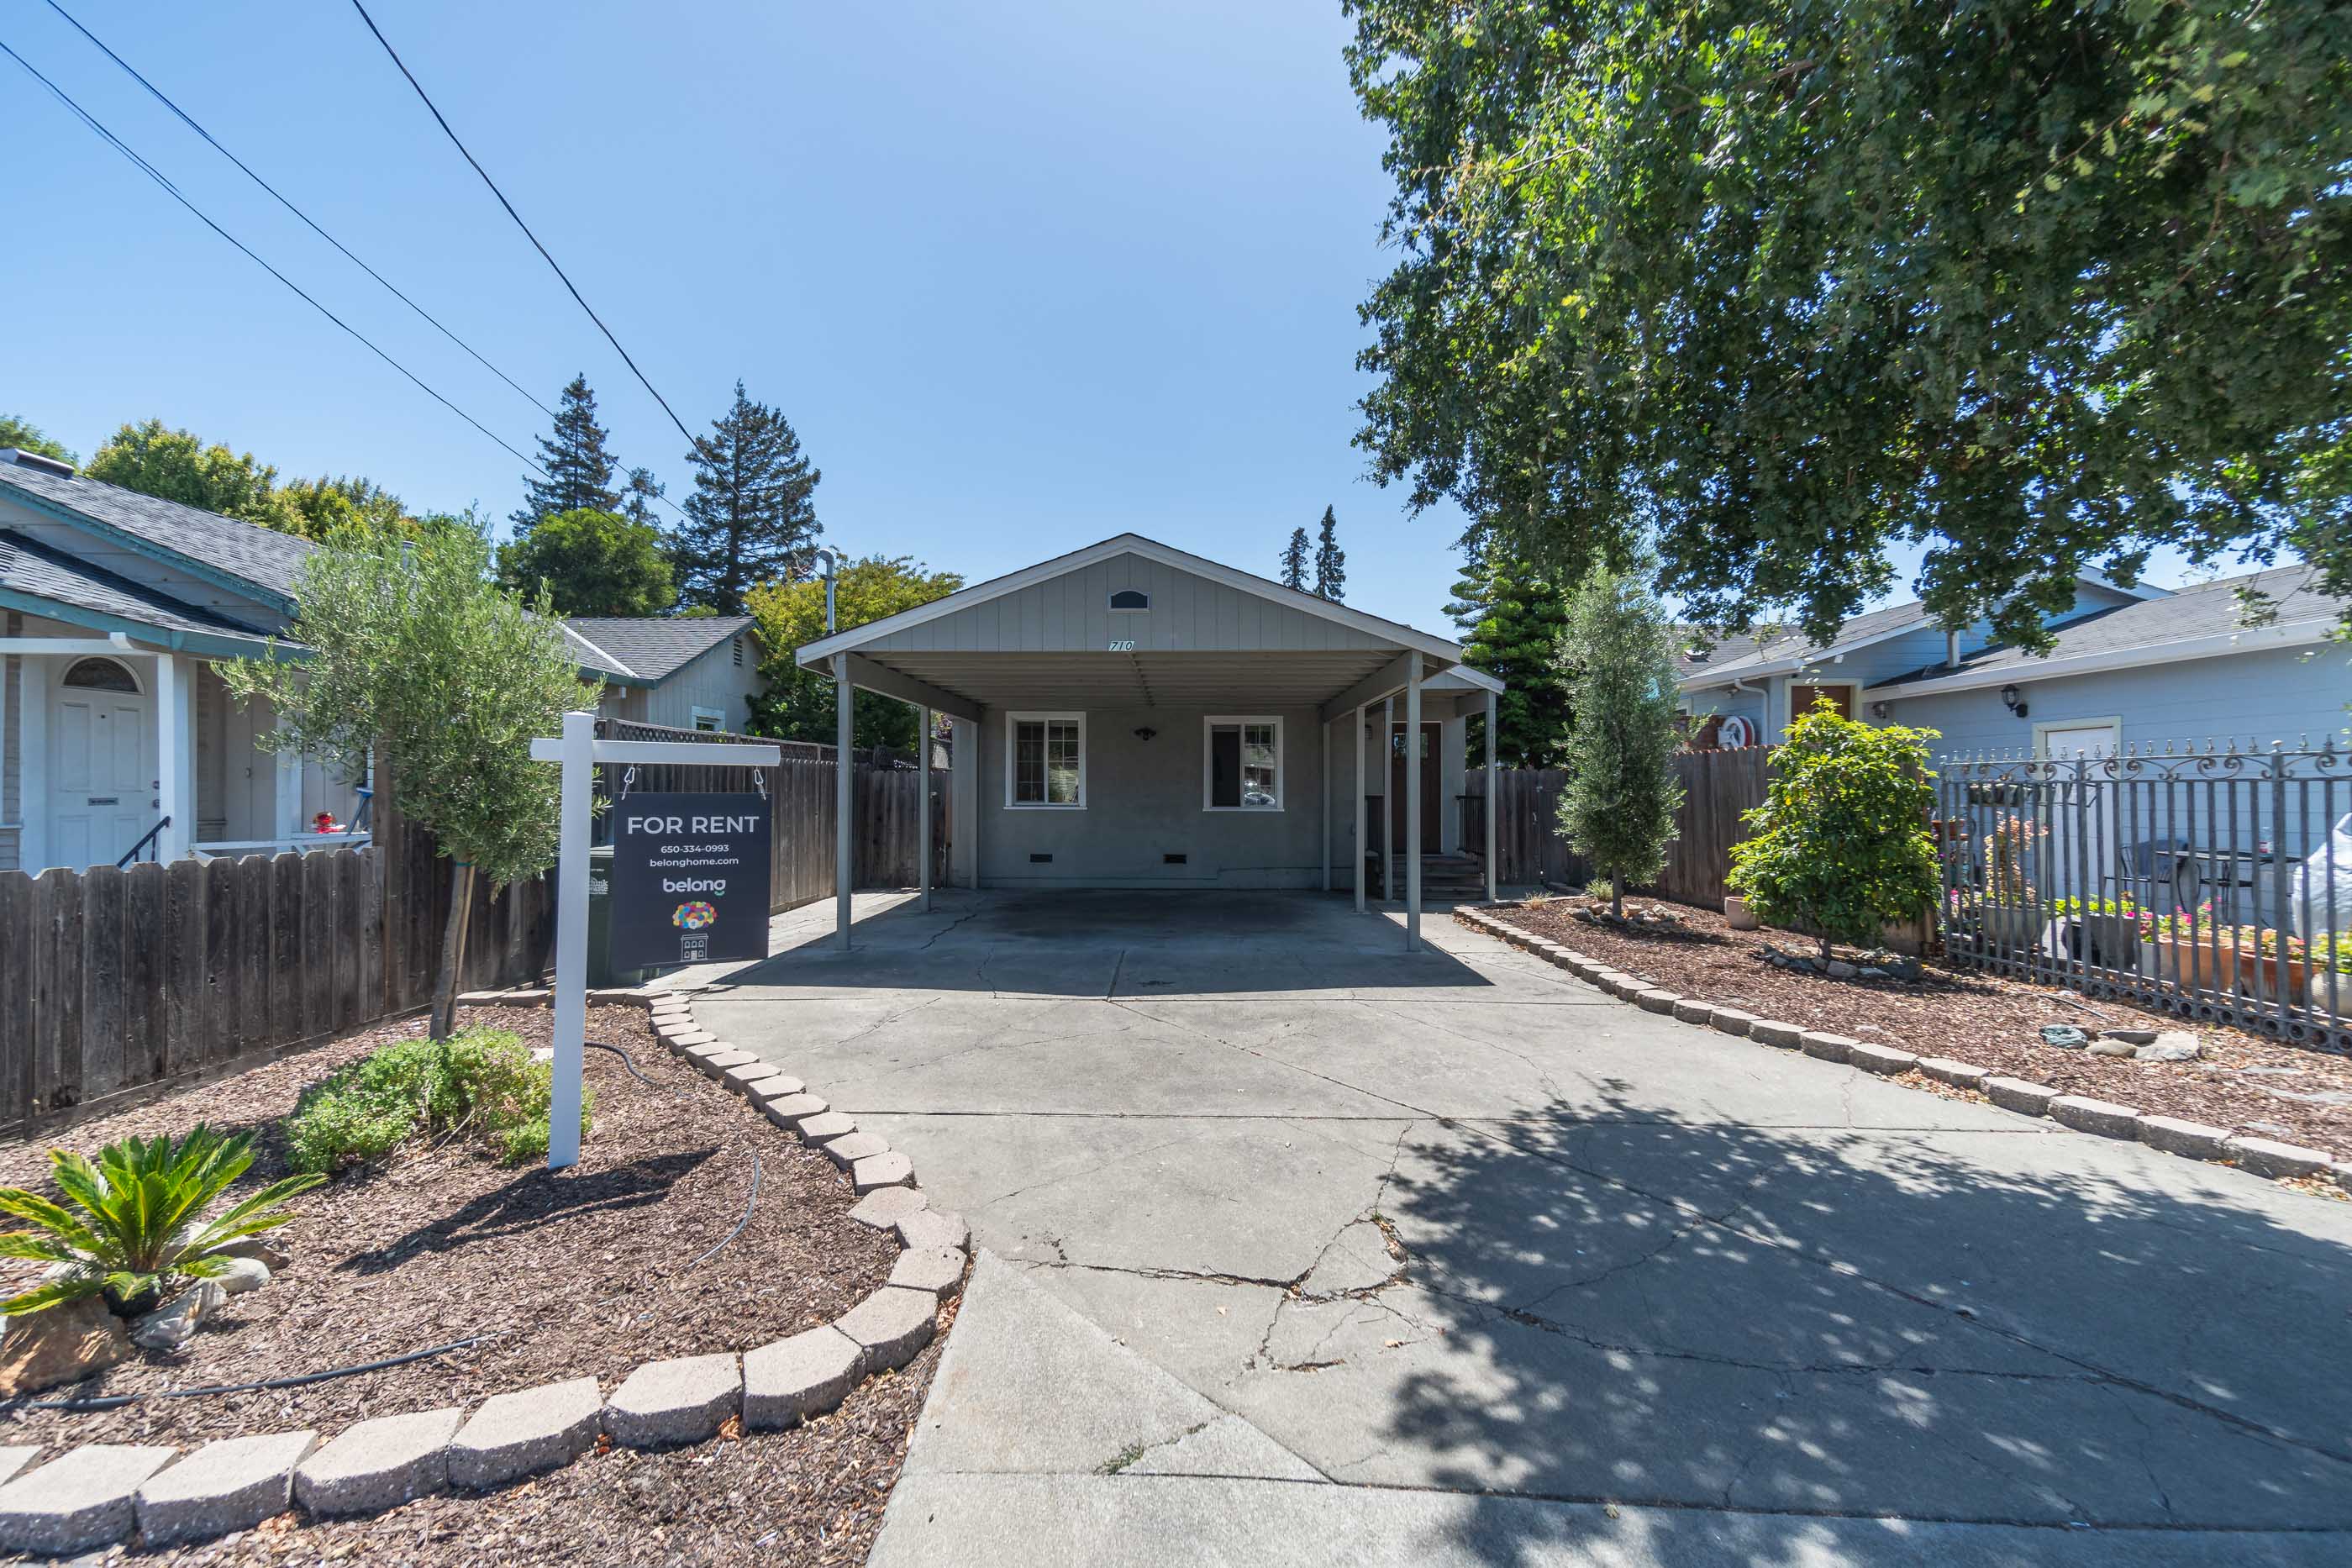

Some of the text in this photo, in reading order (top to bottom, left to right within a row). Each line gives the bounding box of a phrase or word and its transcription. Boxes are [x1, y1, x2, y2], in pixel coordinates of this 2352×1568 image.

[1110, 641, 1134, 651] 710
[627, 815, 760, 834] FOR RENT
[660, 844, 729, 854] 650-334-0993
[649, 857, 739, 867] belonghome.com
[662, 876, 726, 896] belong
